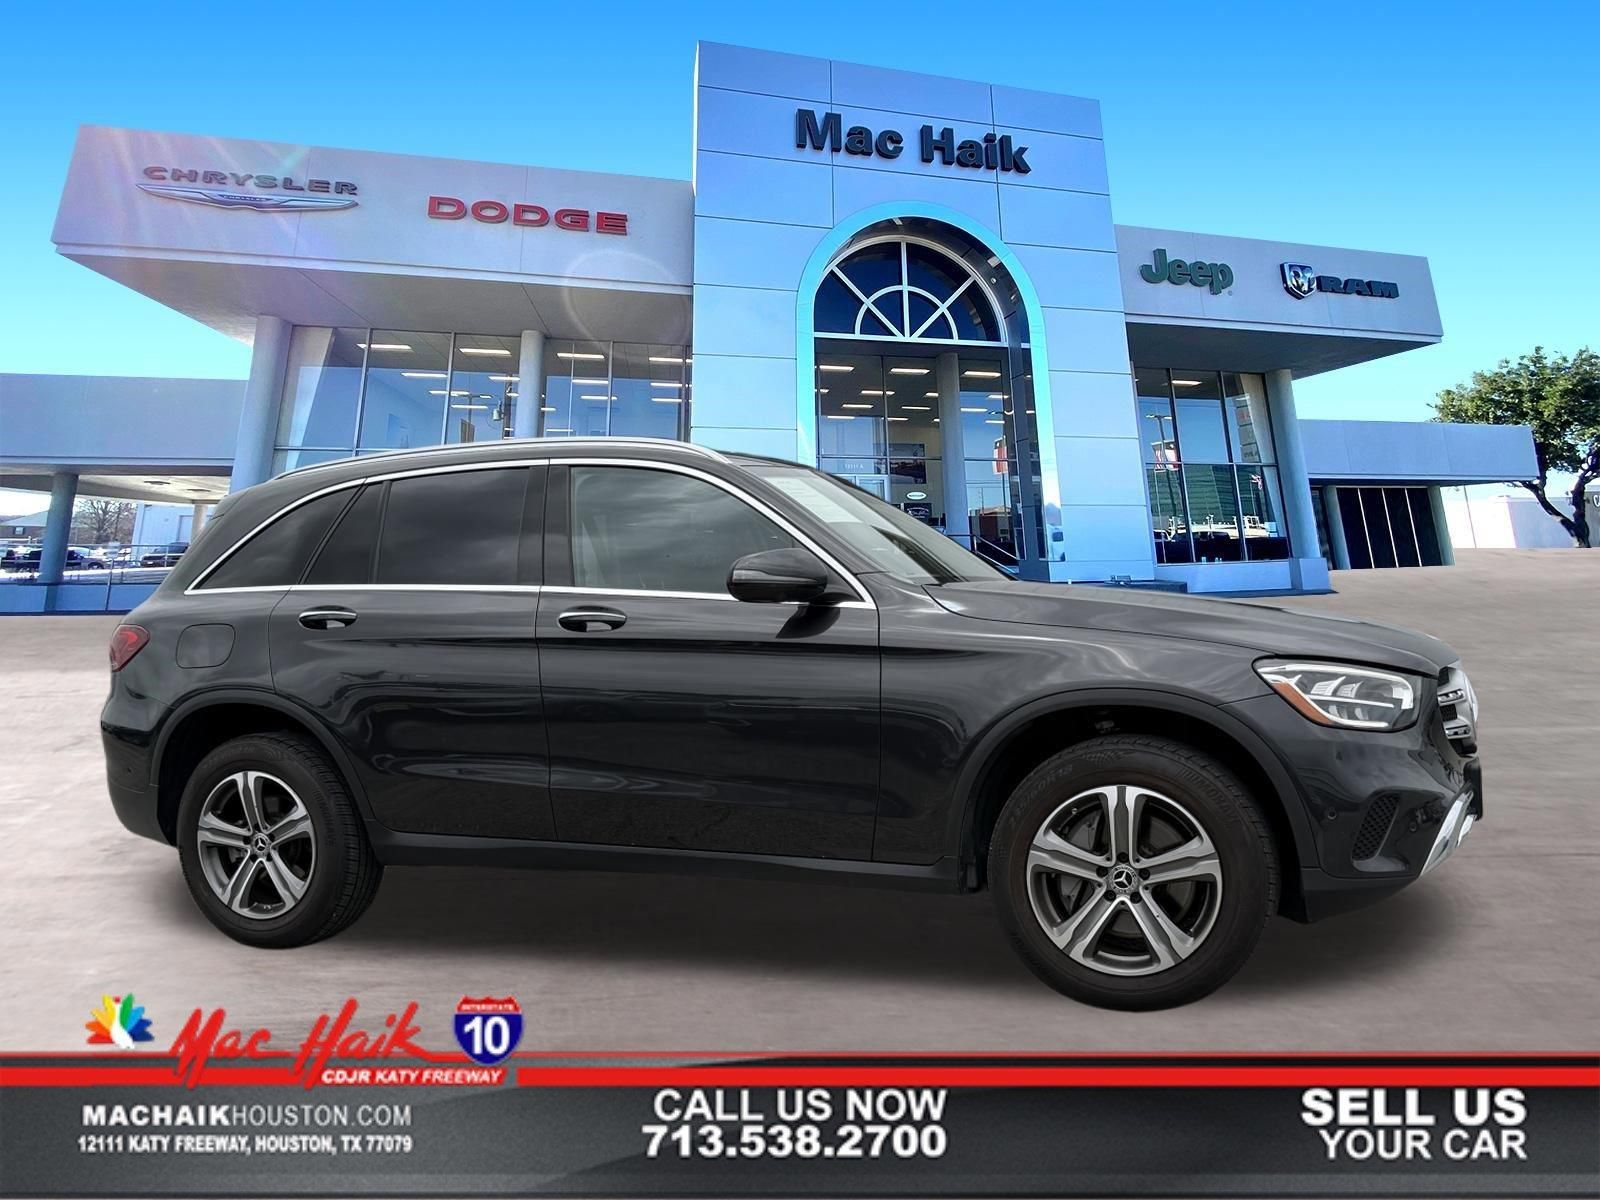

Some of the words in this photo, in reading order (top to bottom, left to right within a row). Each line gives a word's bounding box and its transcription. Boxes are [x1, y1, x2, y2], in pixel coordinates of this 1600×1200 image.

[796, 108, 904, 159] Mac
[920, 125, 1032, 174] Haik
[142, 166, 358, 195] CHRYSLER
[428, 196, 628, 235] DODGE
[1140, 248, 1234, 295] Jeep
[1316, 275, 1399, 299] RAM
